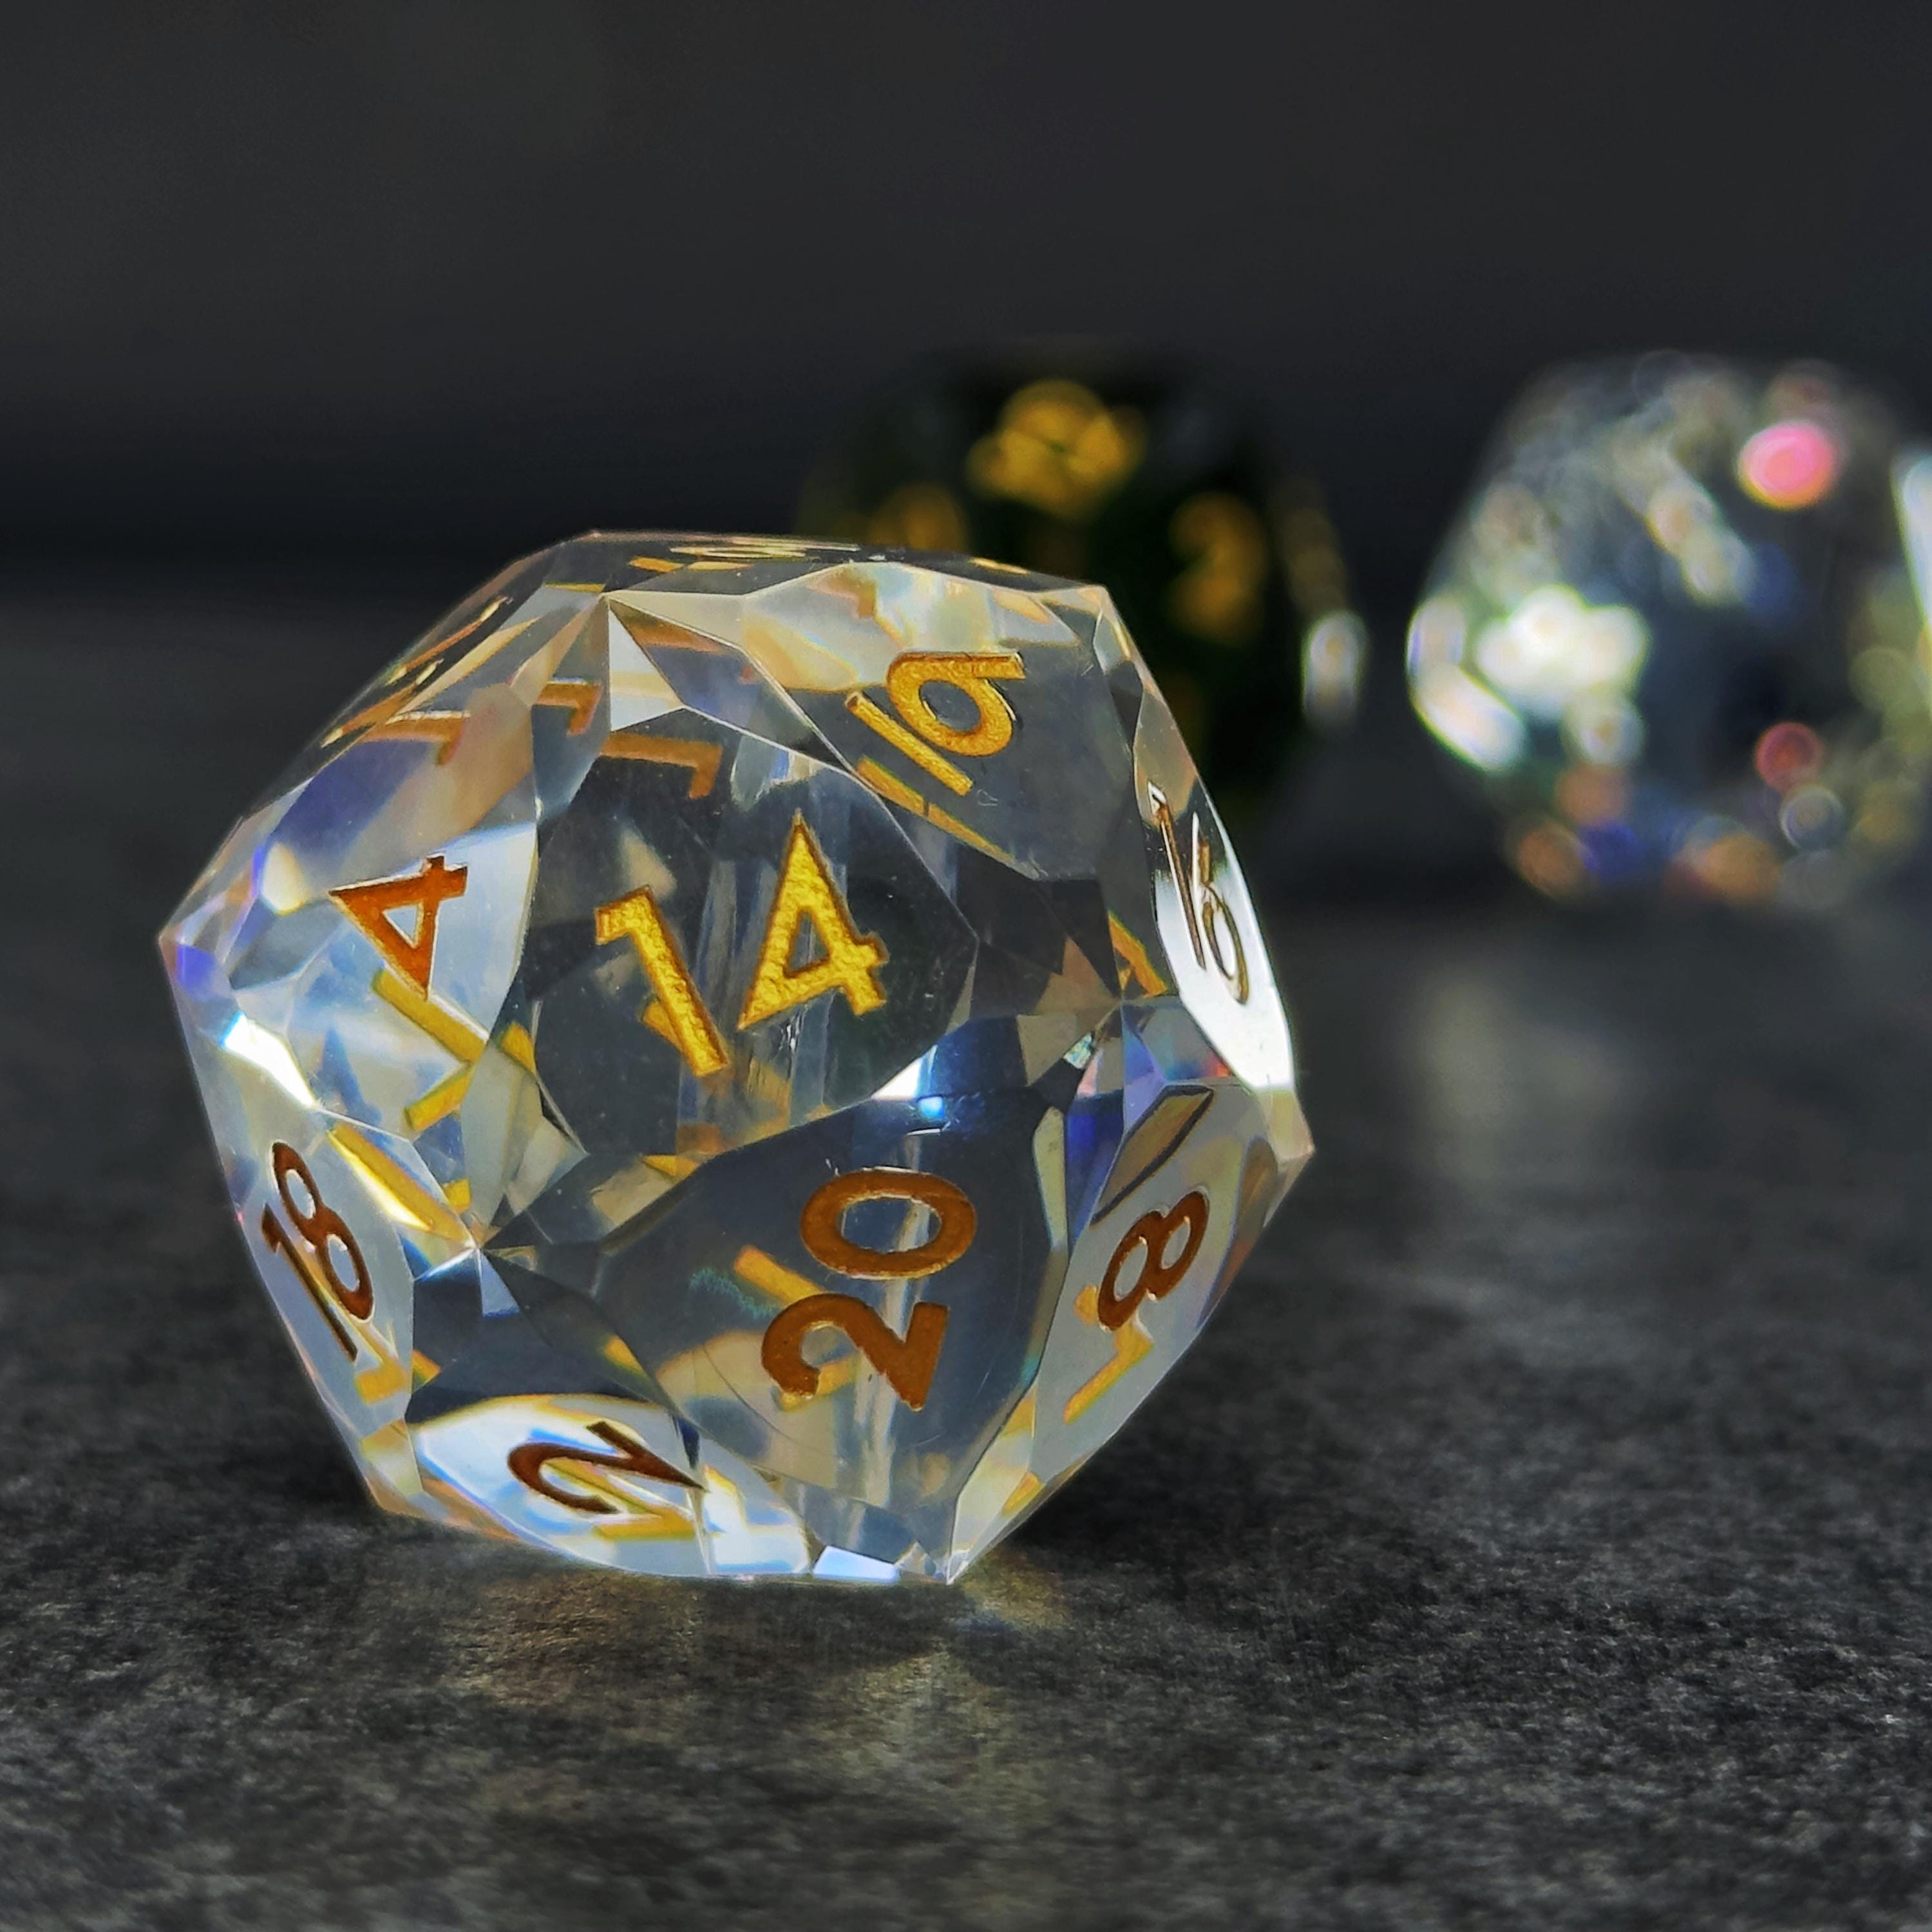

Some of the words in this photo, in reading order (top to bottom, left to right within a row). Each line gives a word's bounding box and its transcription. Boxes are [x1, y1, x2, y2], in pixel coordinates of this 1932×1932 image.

[329, 855, 468, 1000] 4
[594, 810, 888, 1077] 14
[1148, 781, 1249, 1005] 16
[261, 1140, 375, 1363] 18
[761, 1167, 976, 1410] 20
[1098, 1191, 1210, 1331] 8
[509, 1421, 706, 1515] 2
